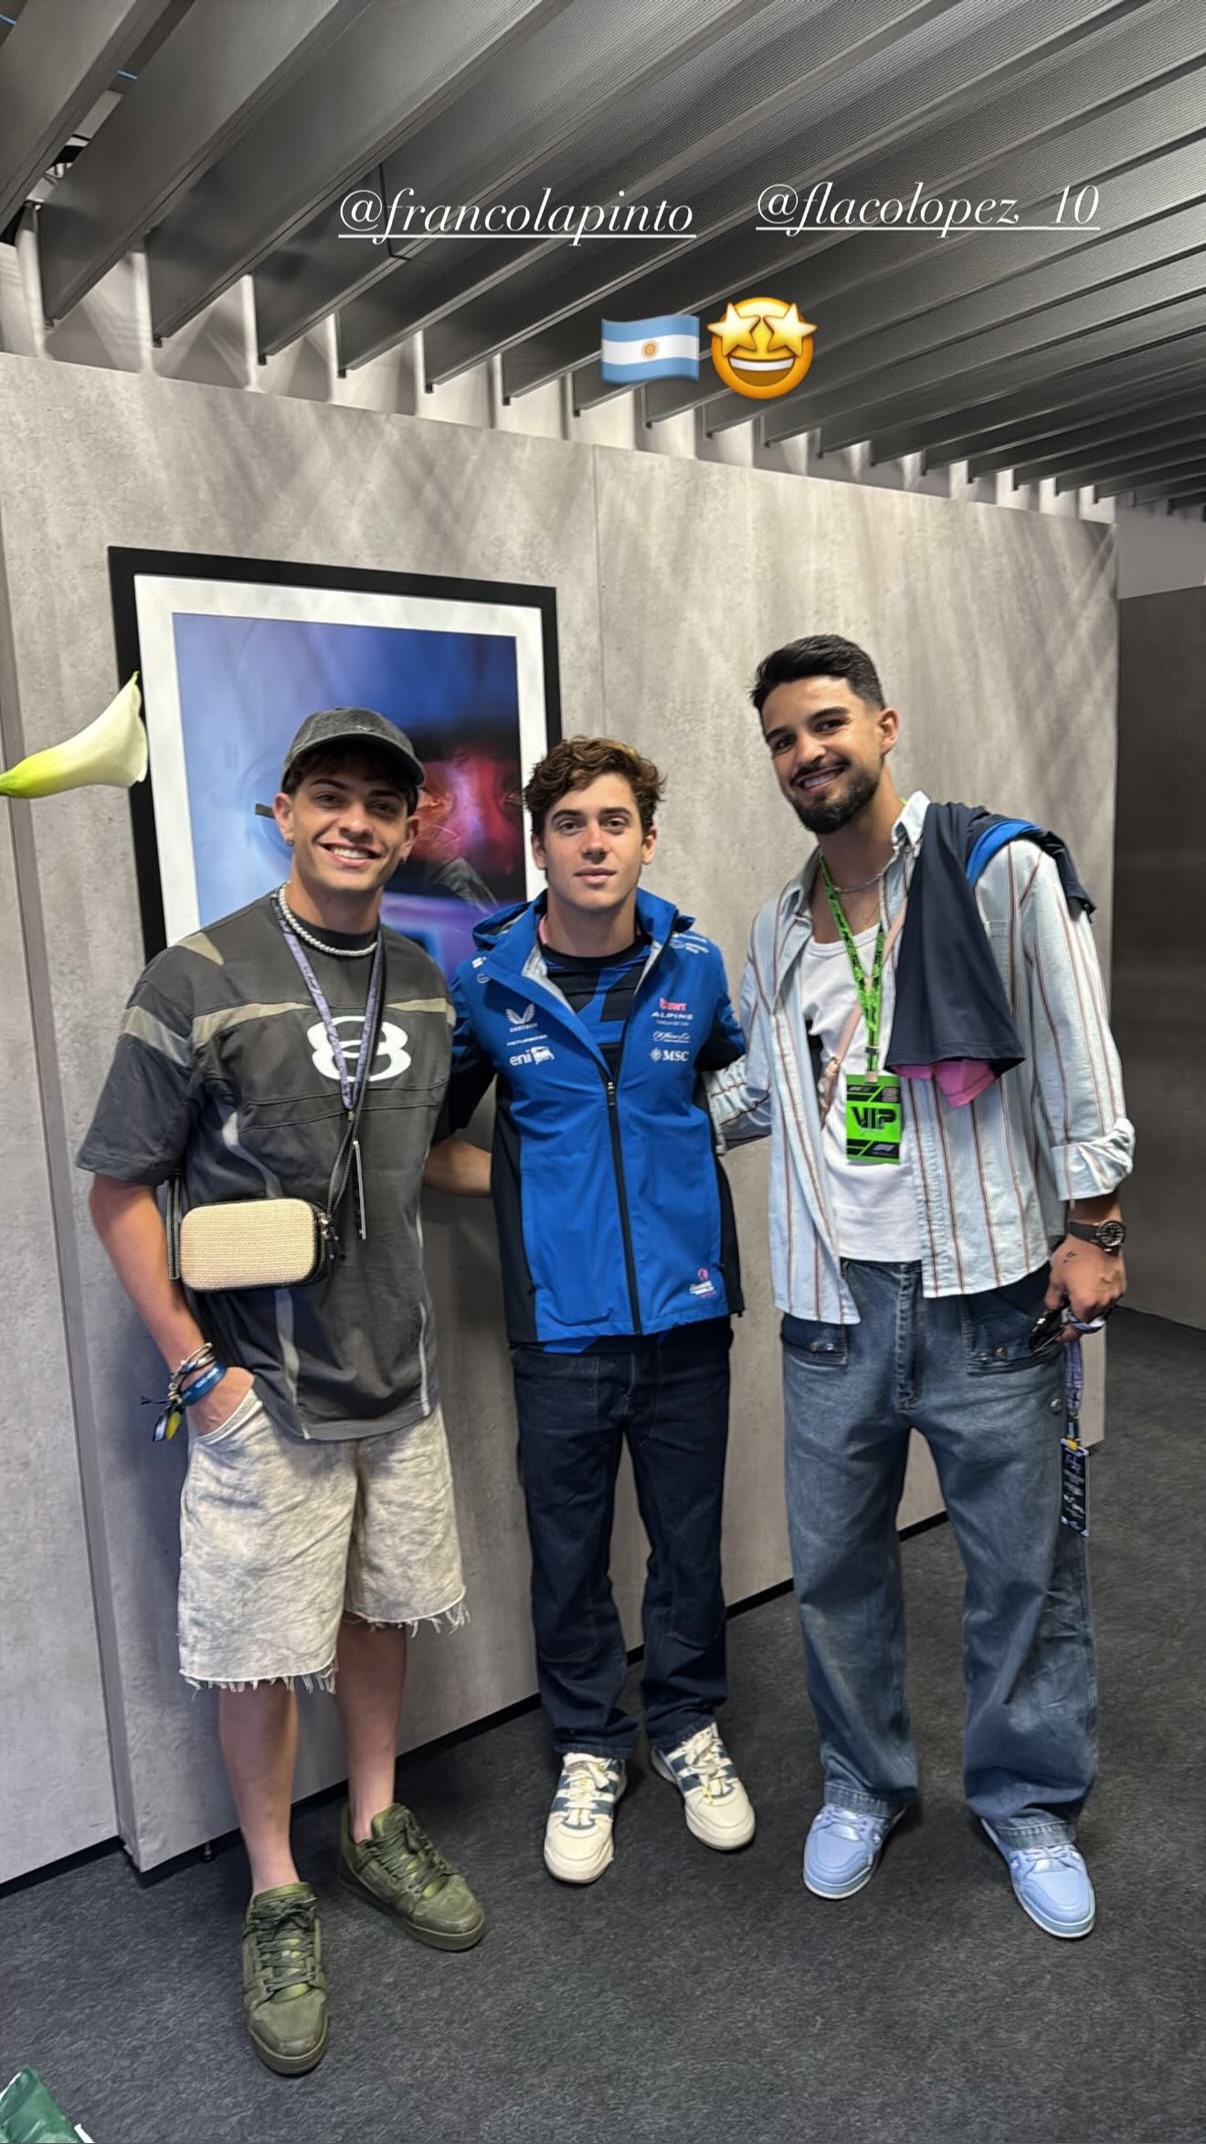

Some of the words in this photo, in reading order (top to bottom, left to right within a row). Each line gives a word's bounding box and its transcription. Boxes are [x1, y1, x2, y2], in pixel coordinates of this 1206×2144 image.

[509, 1049, 532, 1066] eni
[662, 1049, 690, 1062] MSC
[851, 1106, 897, 1130] VIP
